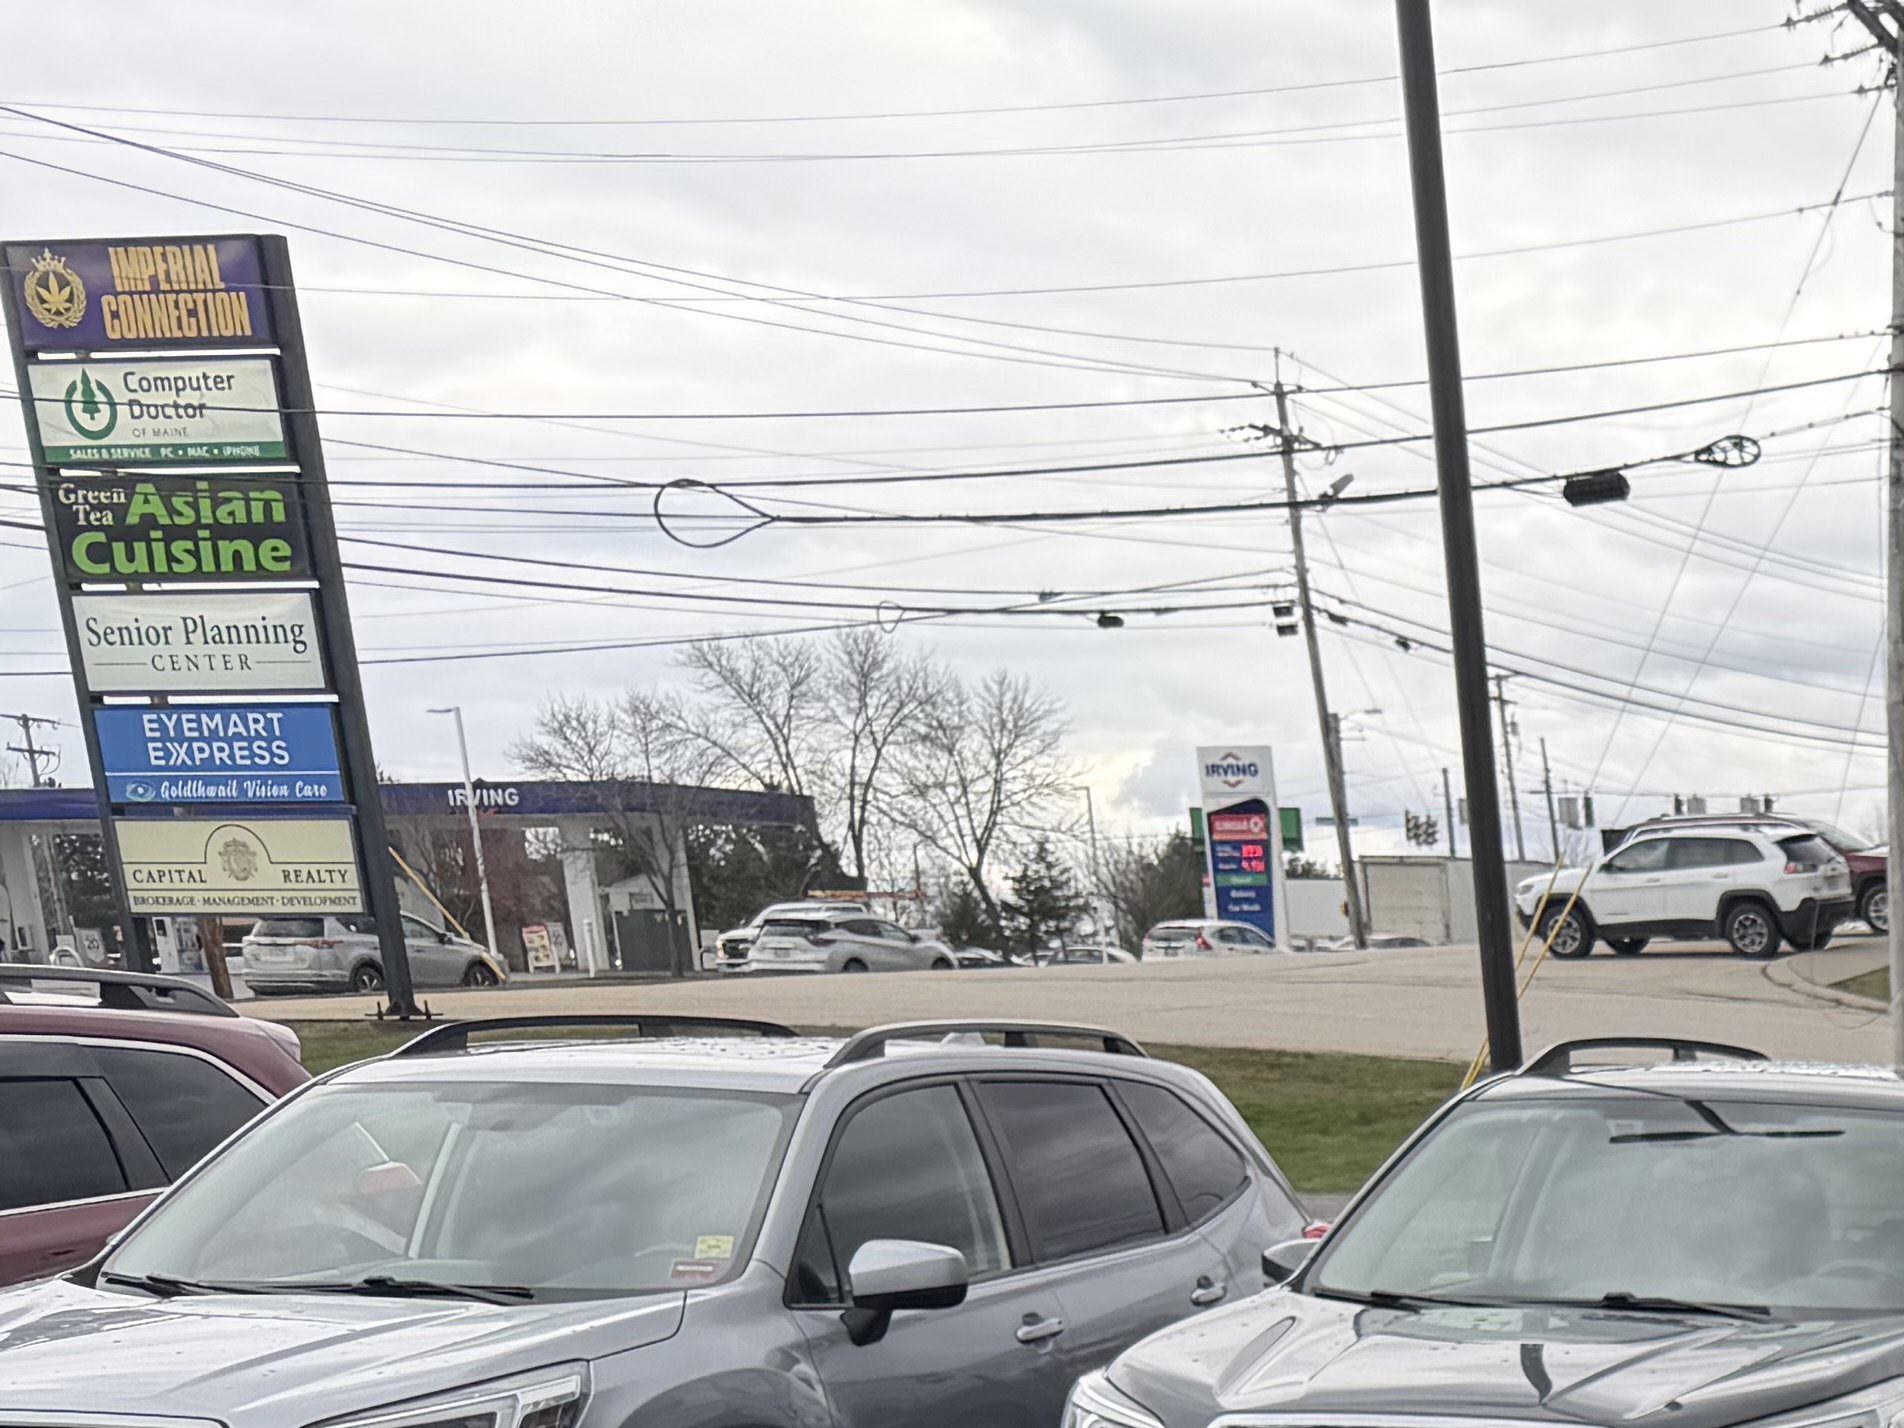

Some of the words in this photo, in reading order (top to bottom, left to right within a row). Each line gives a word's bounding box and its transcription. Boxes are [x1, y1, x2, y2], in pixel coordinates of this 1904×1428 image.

[108, 244, 225, 291] IMPERIAL
[101, 292, 252, 339] CONNECTION
[123, 371, 235, 397] Computer
[128, 399, 207, 420] Doctor
[132, 428, 146, 437] OF
[153, 427, 188, 437] MAINE
[70, 448, 99, 460] SALES
[111, 447, 151, 458] SERVICE
[160, 447, 173, 457] PC
[58, 483, 128, 504] Green
[125, 481, 286, 526] Asian
[73, 505, 114, 526] Tea
[71, 530, 292, 575] Cuisine
[86, 616, 173, 647] Senior
[180, 615, 308, 654] Planning
[151, 653, 252, 672] CENTER
[143, 712, 283, 738] EYEMART
[147, 740, 290, 766] EXPRESS
[1205, 763, 1259, 777] IRVING
[244, 780, 290, 799] Vision
[447, 788, 520, 807] IRVING
[132, 869, 207, 884] CAPITAL
[281, 869, 348, 884] REALTY
[133, 895, 196, 907] BROKERAGE
[202, 895, 276, 907] MANAGEMENT
[280, 895, 357, 906] DEVELOPMENT
